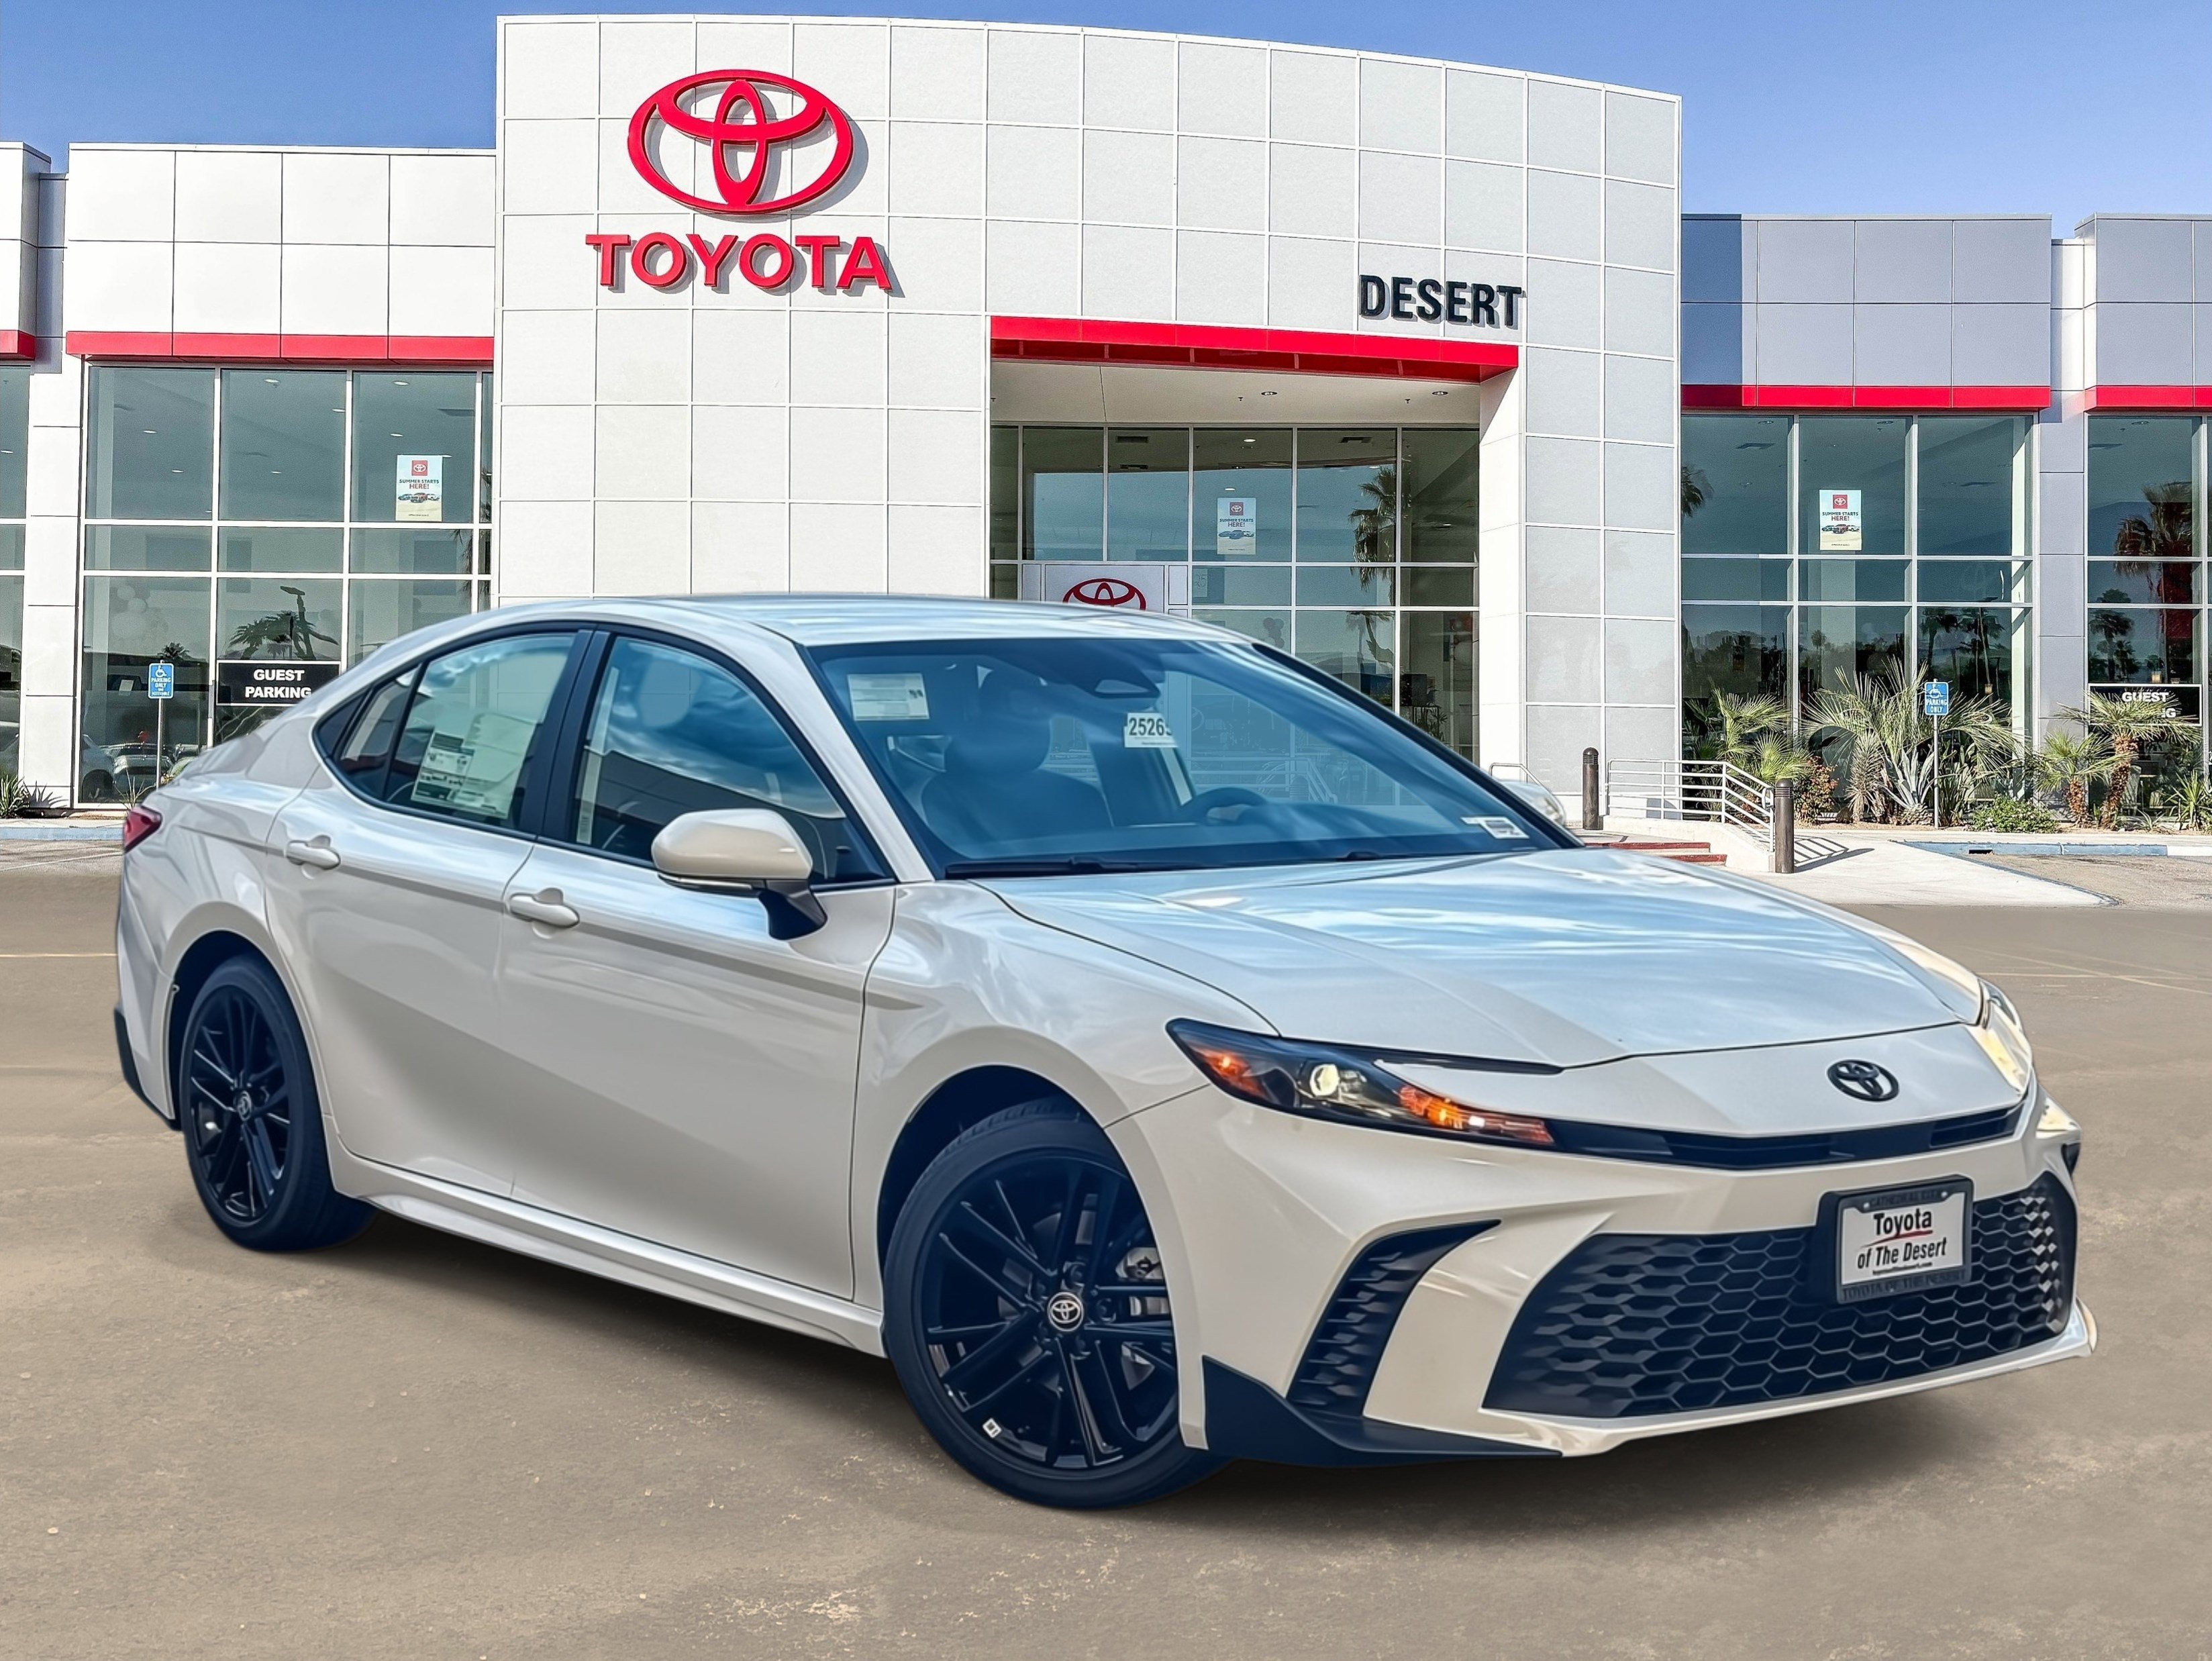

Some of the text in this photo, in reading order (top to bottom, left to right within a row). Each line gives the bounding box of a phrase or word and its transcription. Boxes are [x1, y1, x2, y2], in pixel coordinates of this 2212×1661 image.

[585, 232, 893, 290] TOYOTA
[1359, 274, 1522, 327] DESERT
[253, 669, 305, 681] GUEST
[245, 687, 311, 699] PARKING
[2121, 691, 2169, 702] GUEST
[1873, 1208, 1932, 1237] Toyota
[1858, 1247, 1872, 1269] of
[1876, 1246, 1899, 1266] The
[1903, 1237, 1947, 1262] Desert
